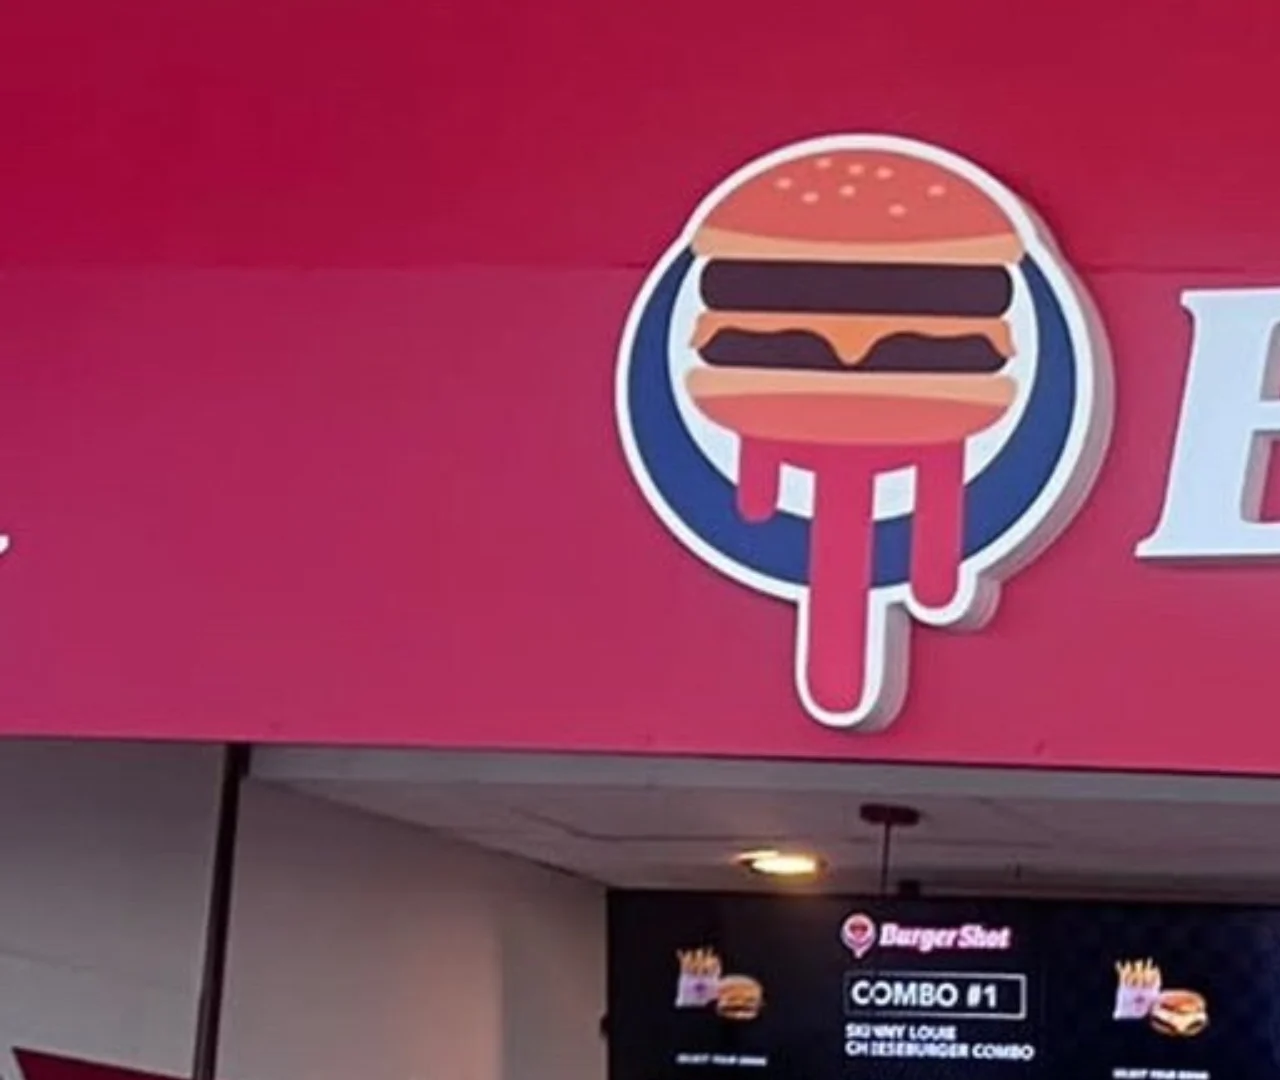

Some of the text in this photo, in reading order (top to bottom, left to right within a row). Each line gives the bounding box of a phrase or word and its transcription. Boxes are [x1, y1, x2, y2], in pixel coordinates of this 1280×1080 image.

[851, 980, 997, 1008] COMBO #1
[972, 1043, 1034, 1060] COMBO
